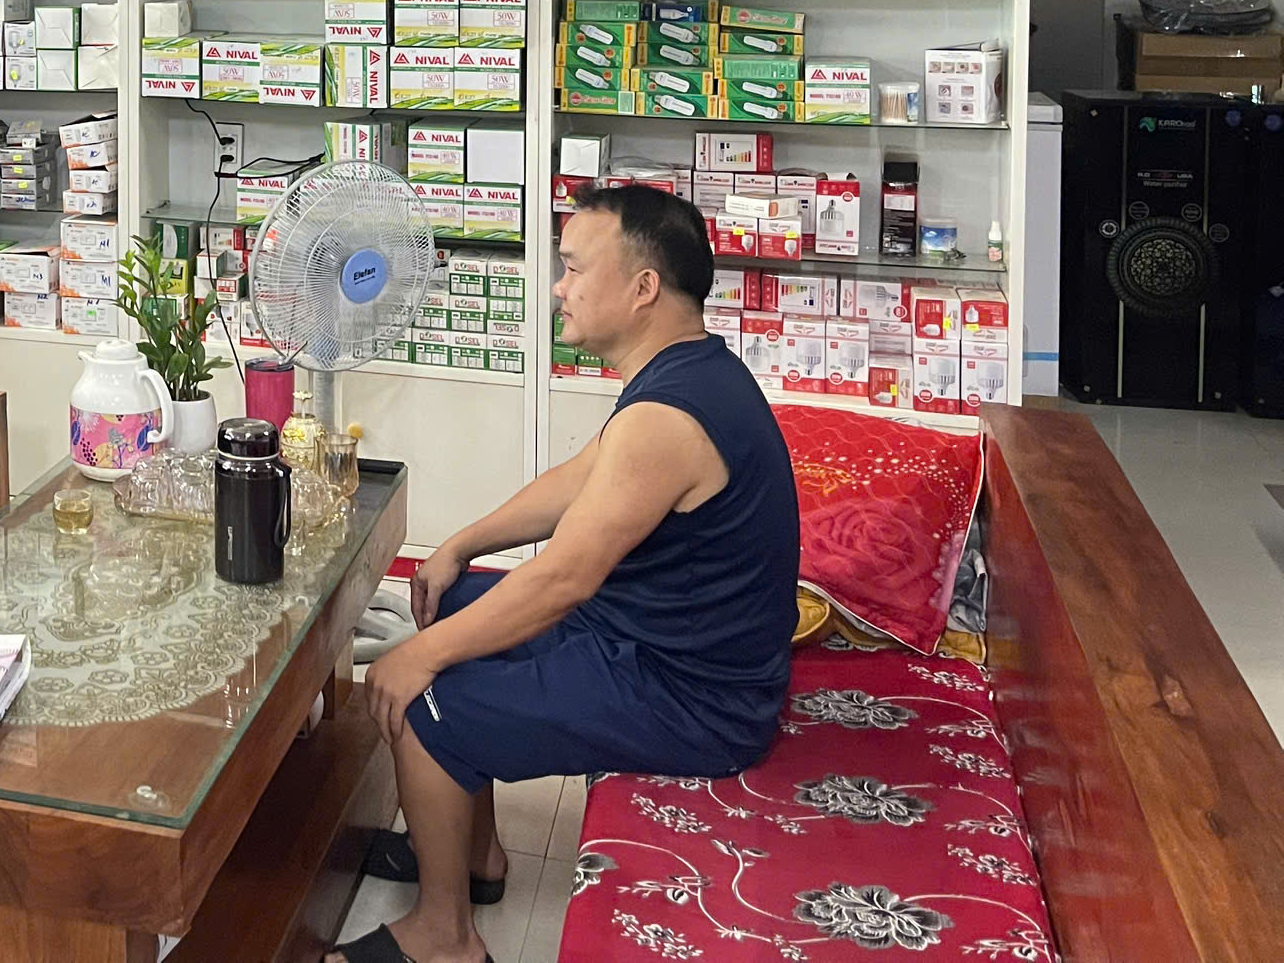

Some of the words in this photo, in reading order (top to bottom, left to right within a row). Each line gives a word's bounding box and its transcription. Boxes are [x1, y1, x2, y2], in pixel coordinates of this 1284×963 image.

[225, 50, 259, 60] NIVAL
[415, 56, 451, 66] NIVAL
[480, 56, 516, 67] NIVAL
[832, 71, 868, 81] NIVAL
[369, 70, 378, 105] NIVAL
[431, 133, 462, 144] NIVAL
[258, 179, 286, 189] NIVAL
[431, 187, 462, 198] NIVAL
[487, 190, 519, 201] NIVAL
